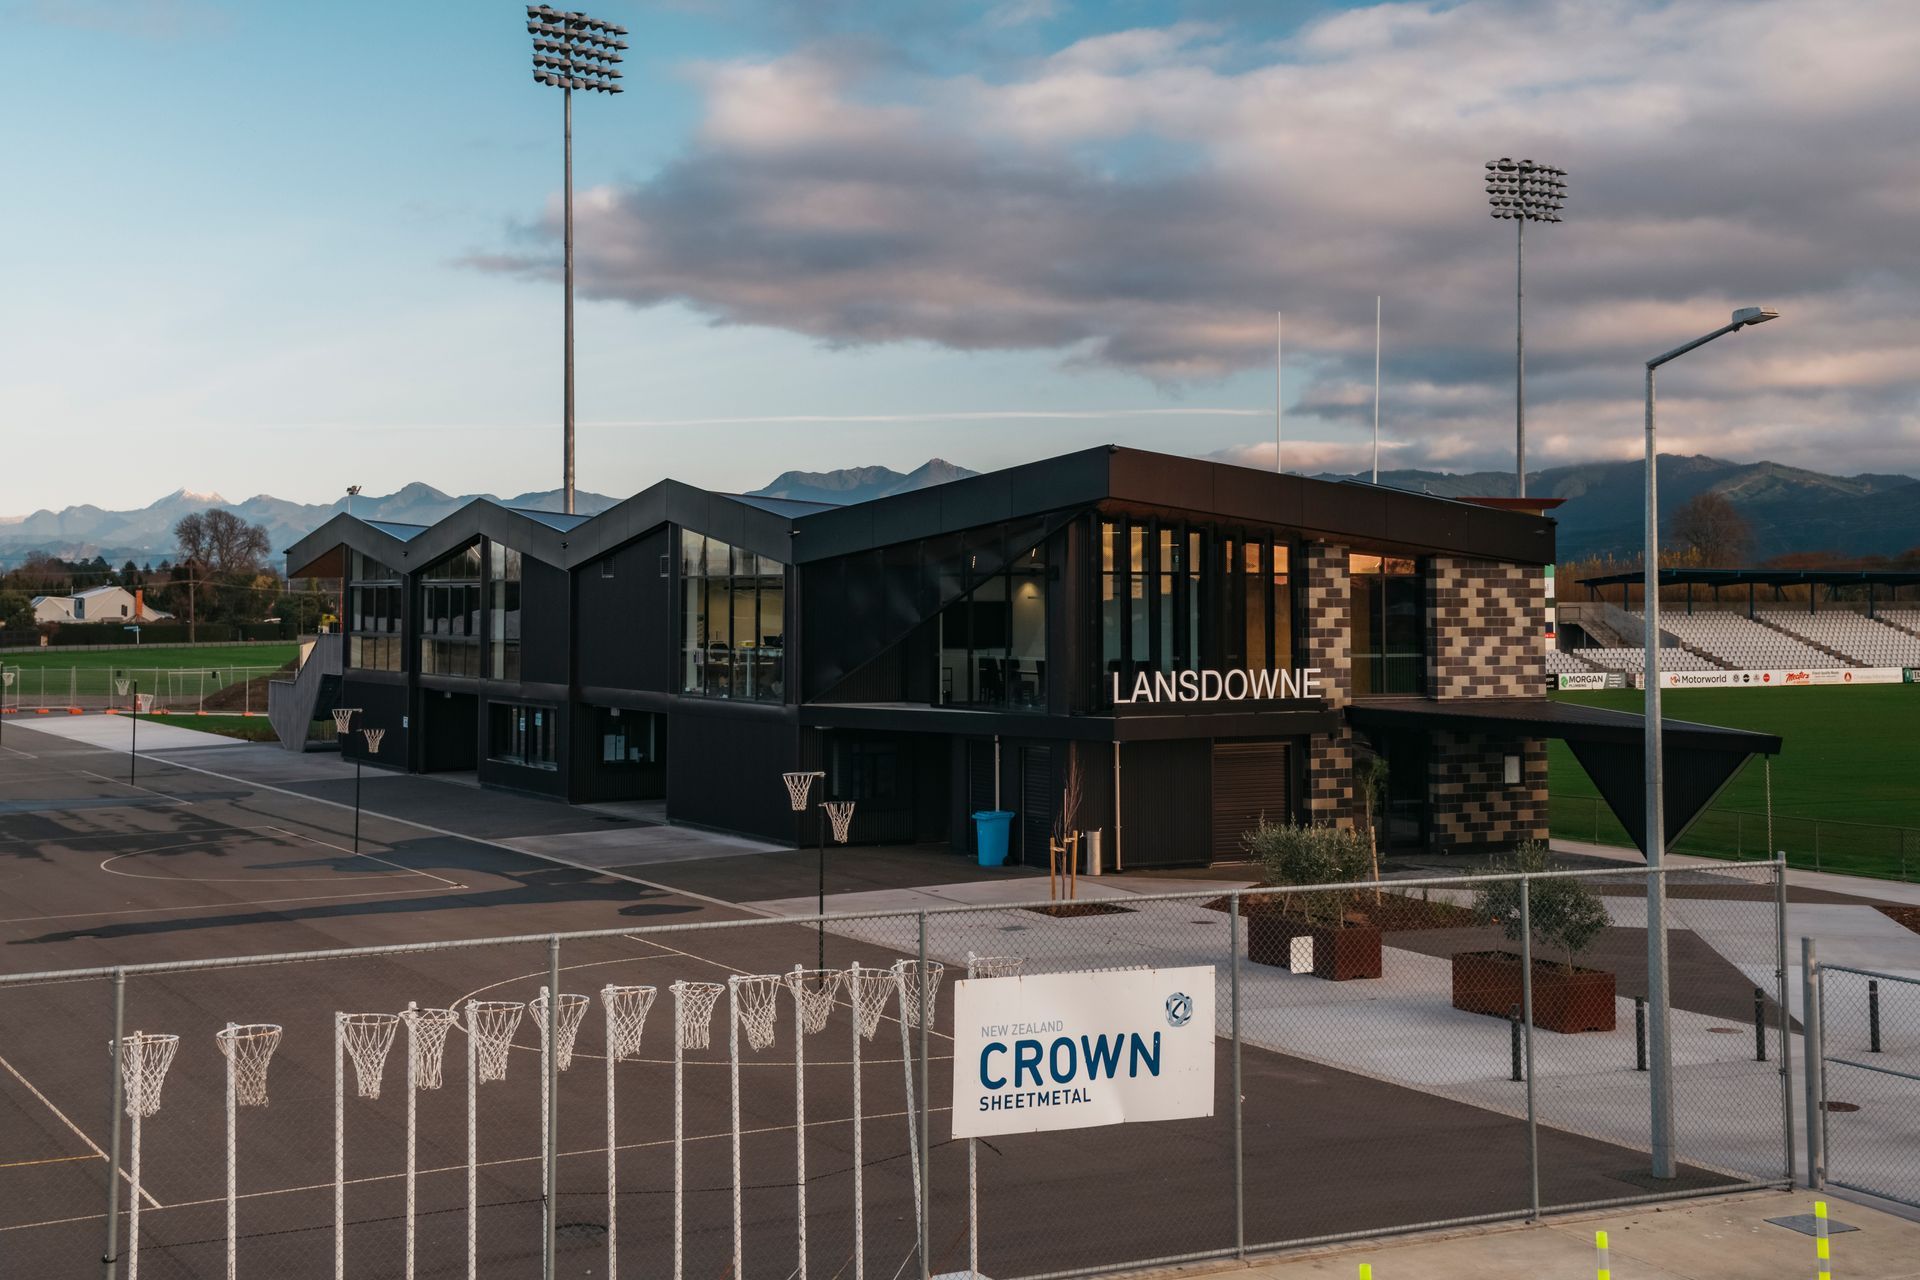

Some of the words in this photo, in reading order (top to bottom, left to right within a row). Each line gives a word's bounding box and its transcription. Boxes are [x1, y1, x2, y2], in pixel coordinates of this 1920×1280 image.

[1113, 668, 1322, 704] LANSDOWNE
[1569, 675, 1604, 683] MORGAN
[1681, 674, 1727, 684] Motorworld
[981, 1024, 1009, 1038] NEW
[1011, 1020, 1064, 1036] ZEALAND
[980, 1031, 1161, 1090] CROWN
[979, 1087, 1091, 1112] SHEETMETAL
